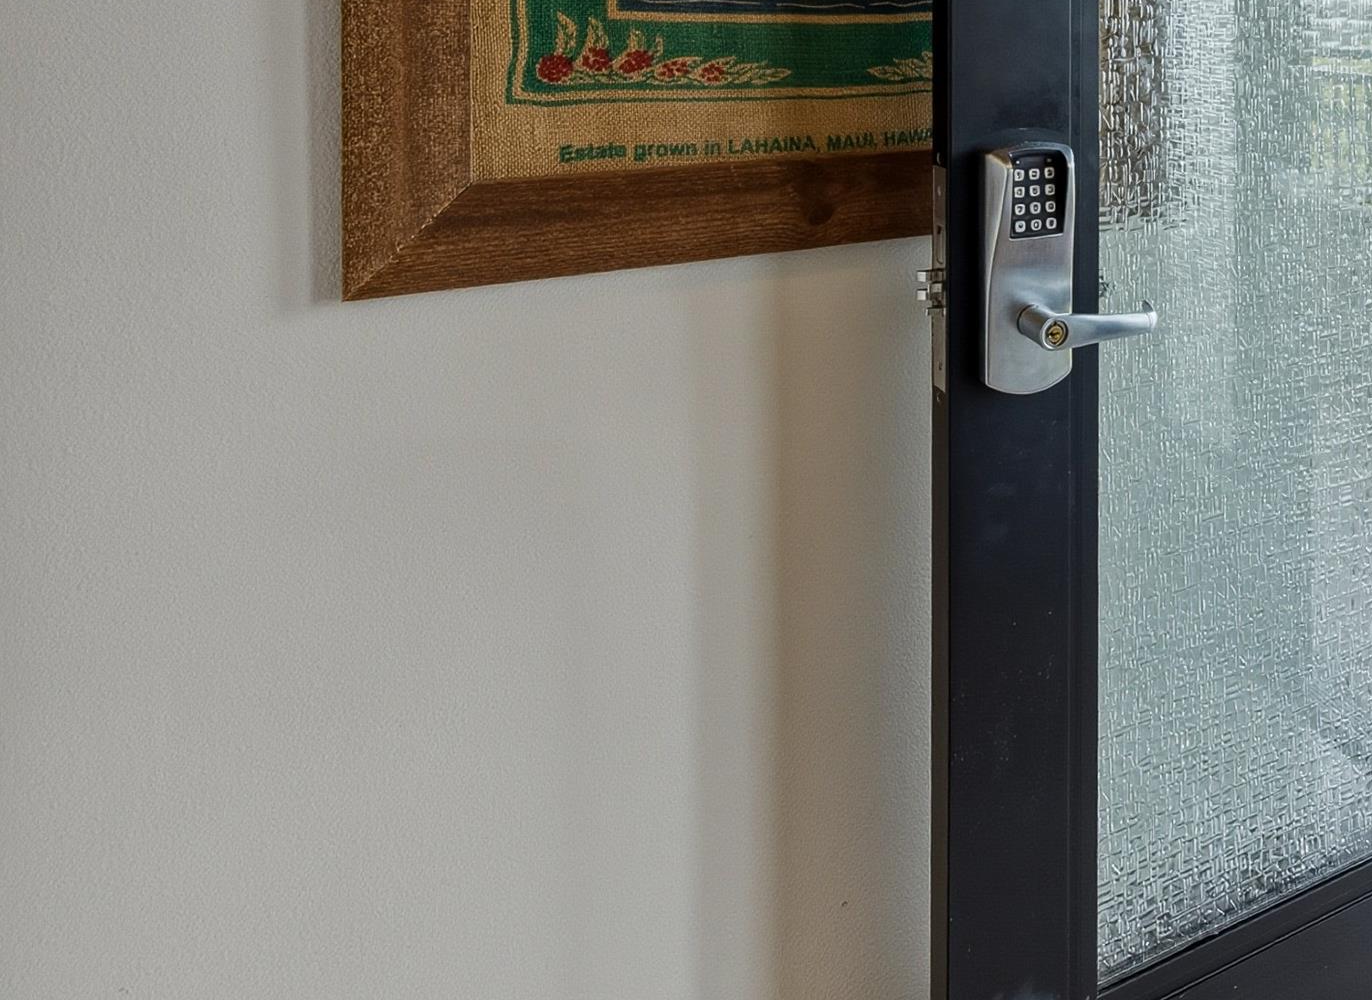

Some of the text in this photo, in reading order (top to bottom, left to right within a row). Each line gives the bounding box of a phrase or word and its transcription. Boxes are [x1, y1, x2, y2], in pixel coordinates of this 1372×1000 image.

[559, 142, 626, 163] Estate
[633, 142, 697, 163] grown
[704, 140, 721, 156] in
[728, 135, 820, 154] LAHAINA,
